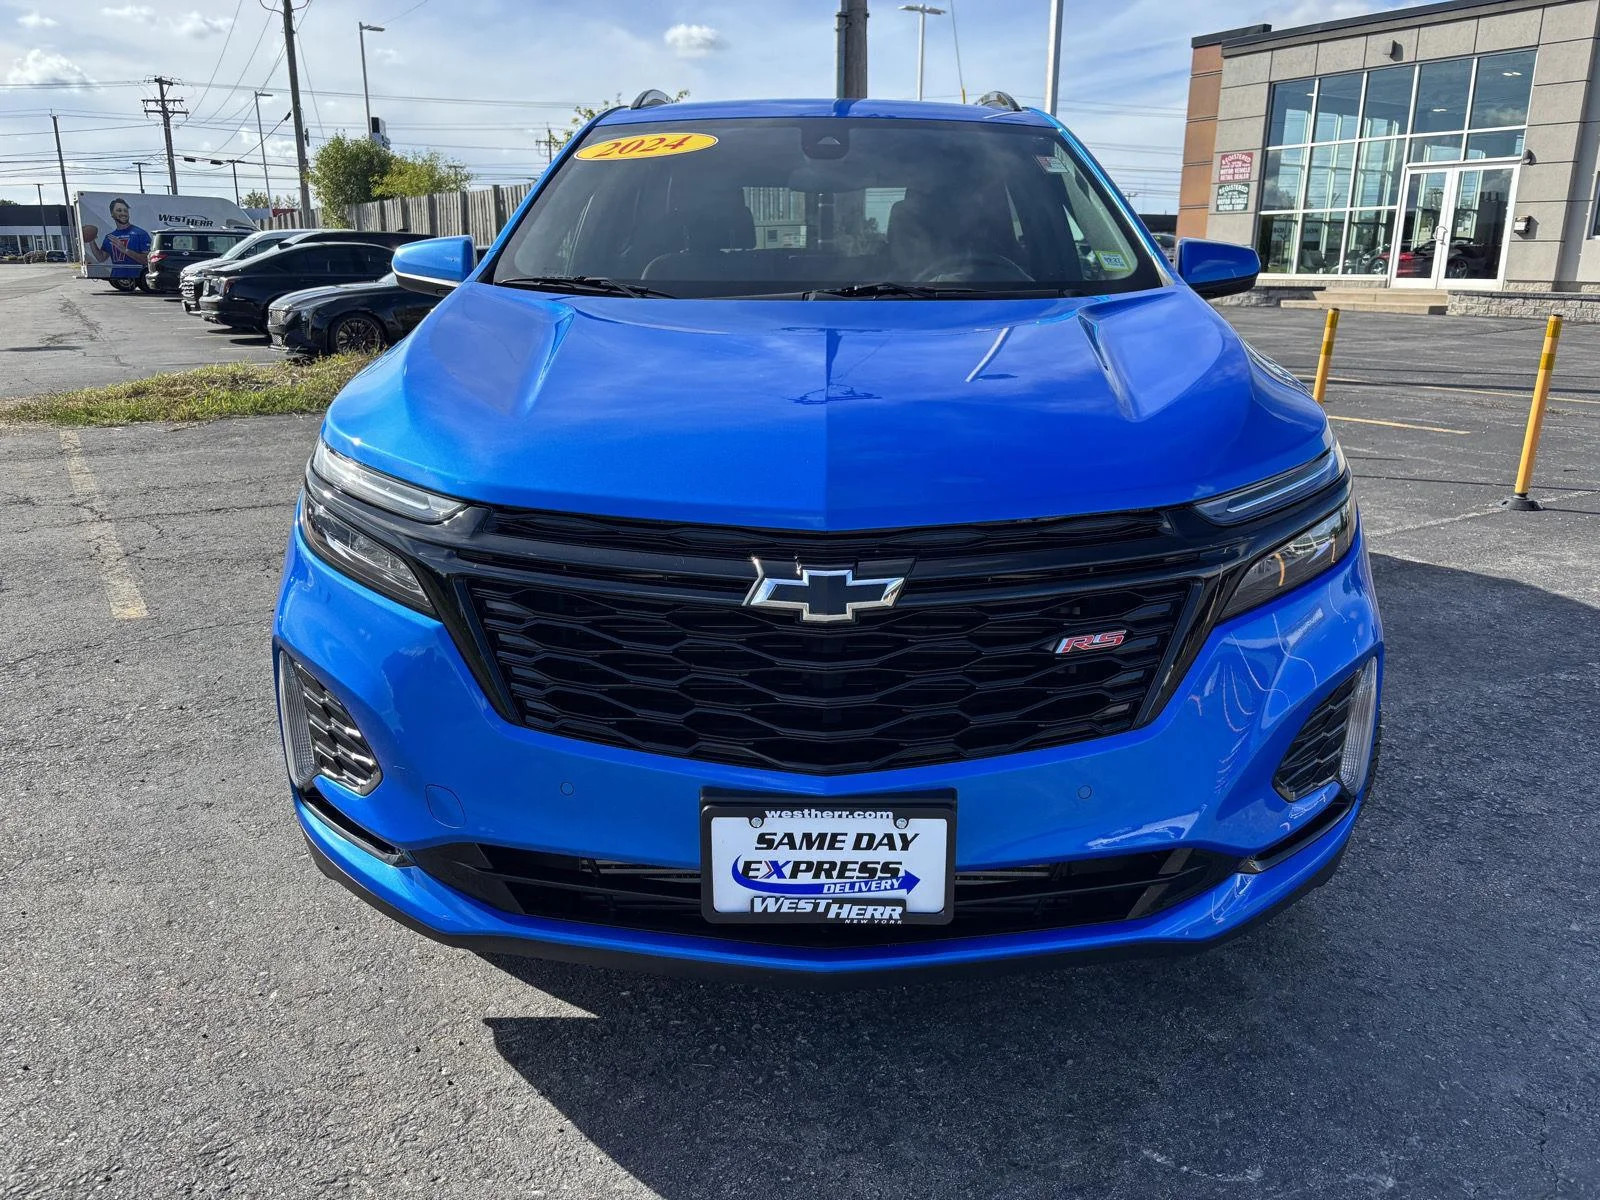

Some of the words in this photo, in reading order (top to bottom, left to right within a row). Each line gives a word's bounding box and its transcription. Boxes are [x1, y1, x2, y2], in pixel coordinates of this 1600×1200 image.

[591, 135, 692, 159] 2024
[158, 214, 186, 223] WEST
[186, 218, 214, 227] HERR
[1056, 629, 1127, 654] RS
[764, 808, 894, 820] westherr.com
[755, 832, 848, 851] SAME
[852, 832, 920, 851] DAY
[741, 860, 903, 880] EXPRESS
[822, 877, 903, 894] DELIVERY
[753, 897, 833, 913] WEST
[826, 903, 904, 920] HERR
